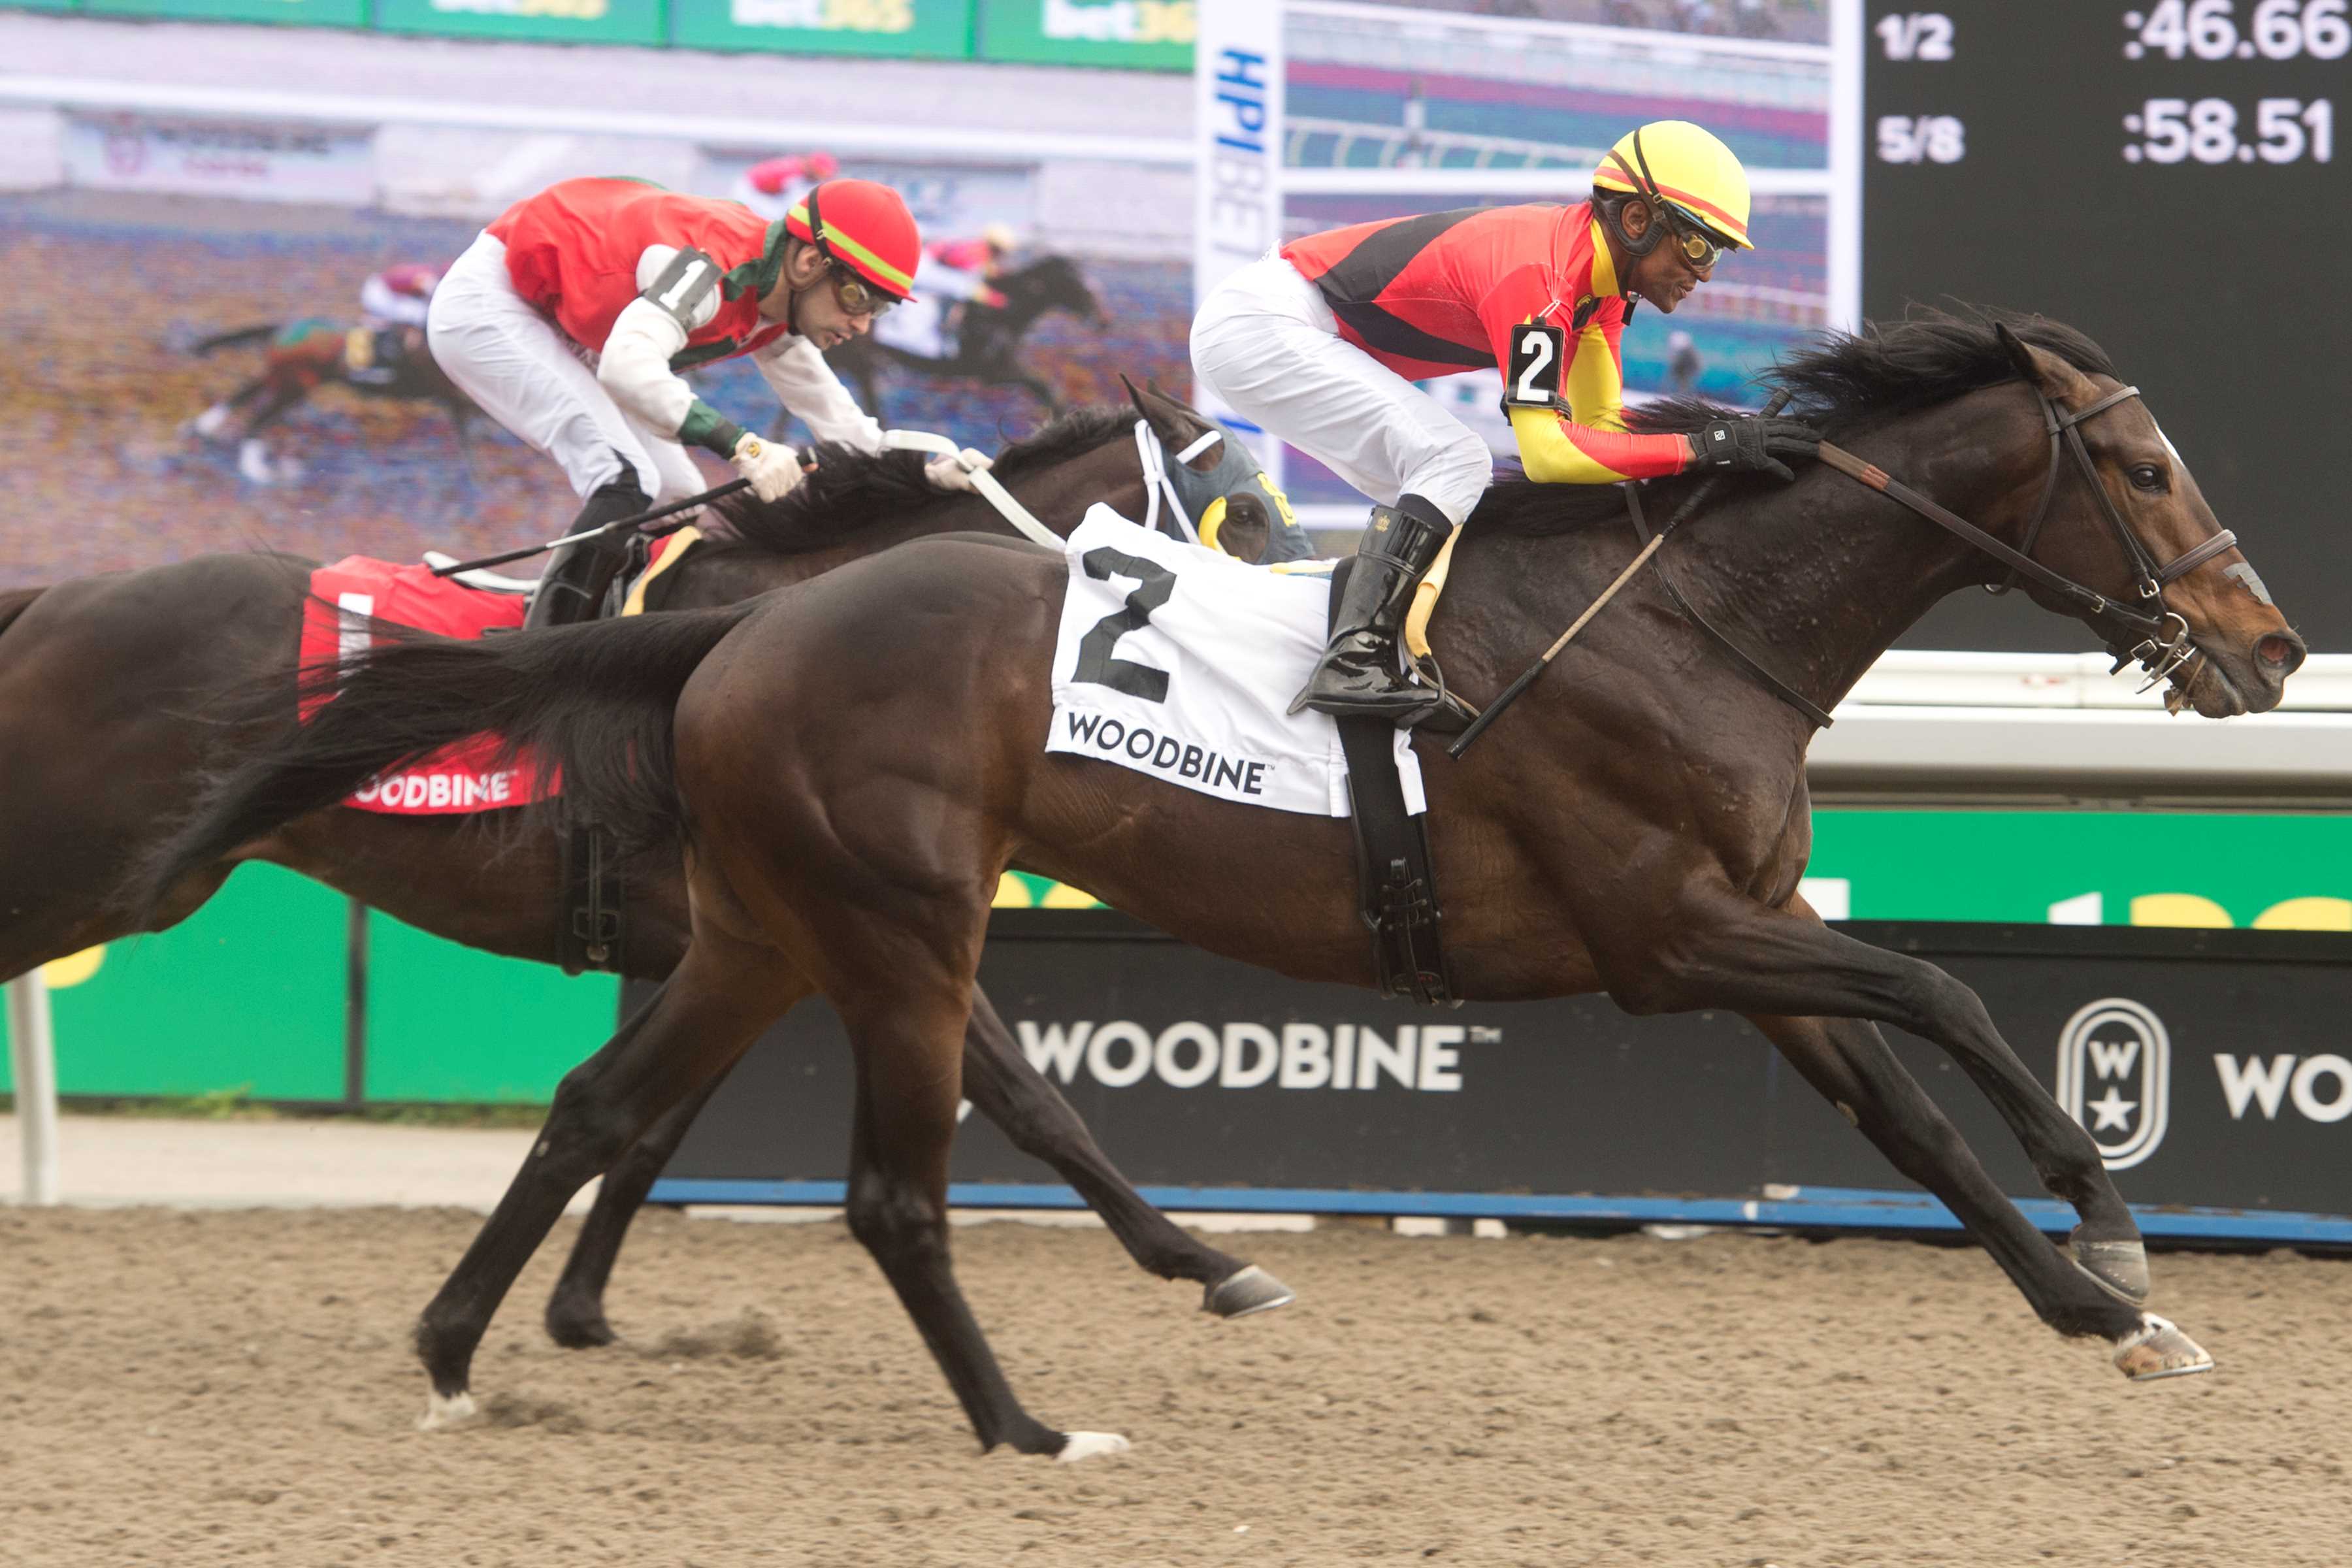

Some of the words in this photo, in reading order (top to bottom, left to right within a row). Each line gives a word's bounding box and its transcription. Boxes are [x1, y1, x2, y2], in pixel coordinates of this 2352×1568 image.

[1042, 0, 1197, 43] bet36
[1876, 13, 1955, 61] 1/2
[2123, 0, 2352, 60] :46.66
[1876, 116, 1966, 163] 5/8
[2123, 98, 2333, 163] :58.51
[658, 259, 708, 310] 1
[1516, 331, 1554, 402] 2
[1070, 546, 1177, 704] 2
